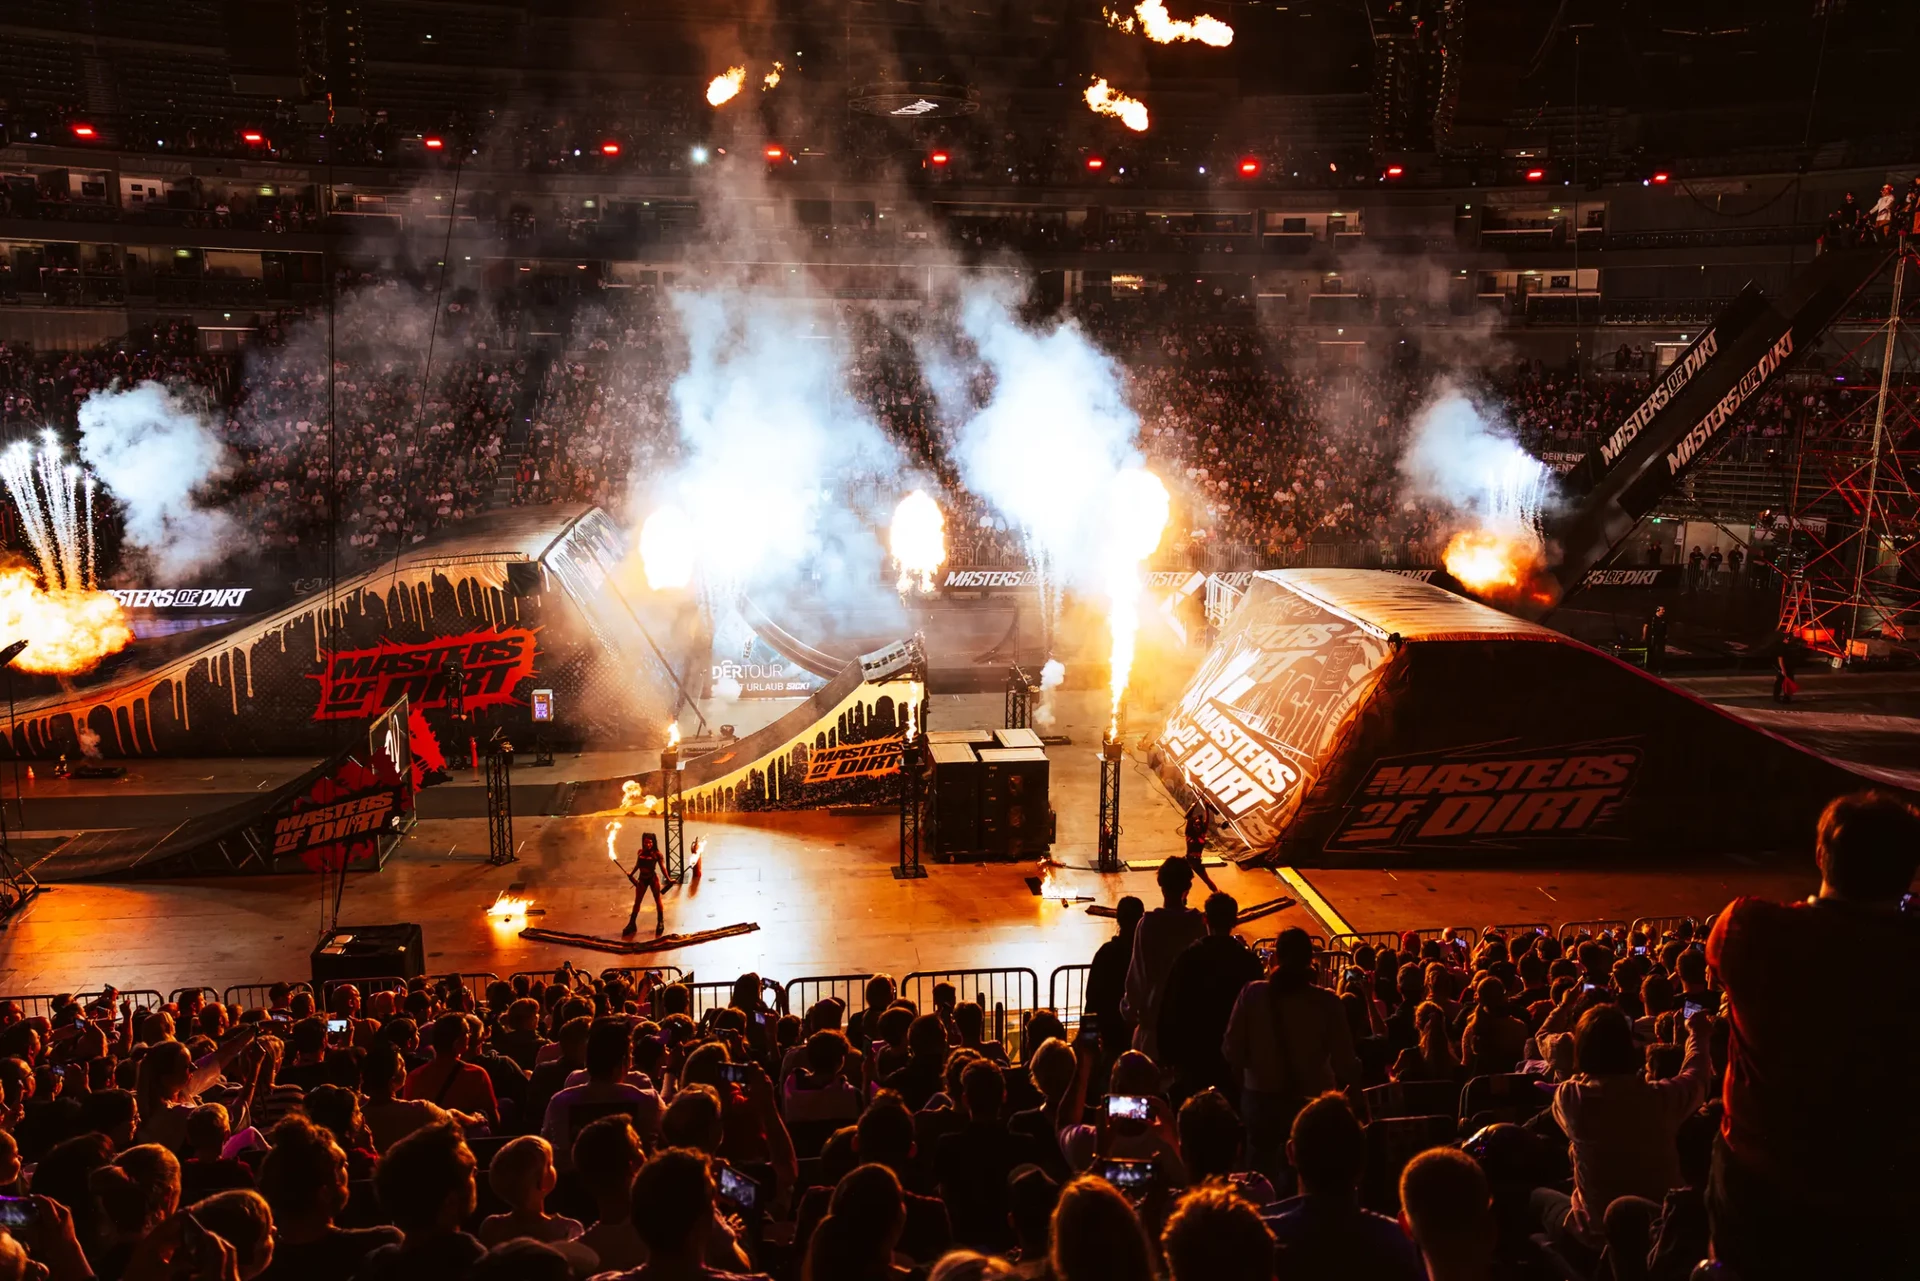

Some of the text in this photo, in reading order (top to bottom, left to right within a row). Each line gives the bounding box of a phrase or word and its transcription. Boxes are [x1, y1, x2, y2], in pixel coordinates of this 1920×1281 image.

[1600, 327, 1718, 466] MASTERS OF DIRT
[1666, 326, 1794, 475] MASTERS OF DIRT
[1542, 452, 1563, 461] DEIN
[944, 571, 1023, 587] MASTERS
[1621, 569, 1663, 585] DIRT
[105, 588, 253, 608] STERS OF DIRT
[331, 636, 526, 680] MASTERS
[712, 662, 784, 679] DERTOUR
[326, 682, 377, 706] OF
[747, 683, 784, 691] URLAUB
[786, 682, 810, 690] SICK!
[1329, 697, 1353, 727] SINCE
[813, 742, 903, 763] MASTERS
[1193, 702, 1297, 793] MASTERS
[811, 753, 902, 777] OF DIRT
[1176, 725, 1276, 814] OF DIRT
[1363, 753, 1637, 796] MASTERS
[275, 791, 394, 834] MASTERS
[1416, 787, 1622, 838] DIRT
[274, 806, 393, 851] OF DIRT
